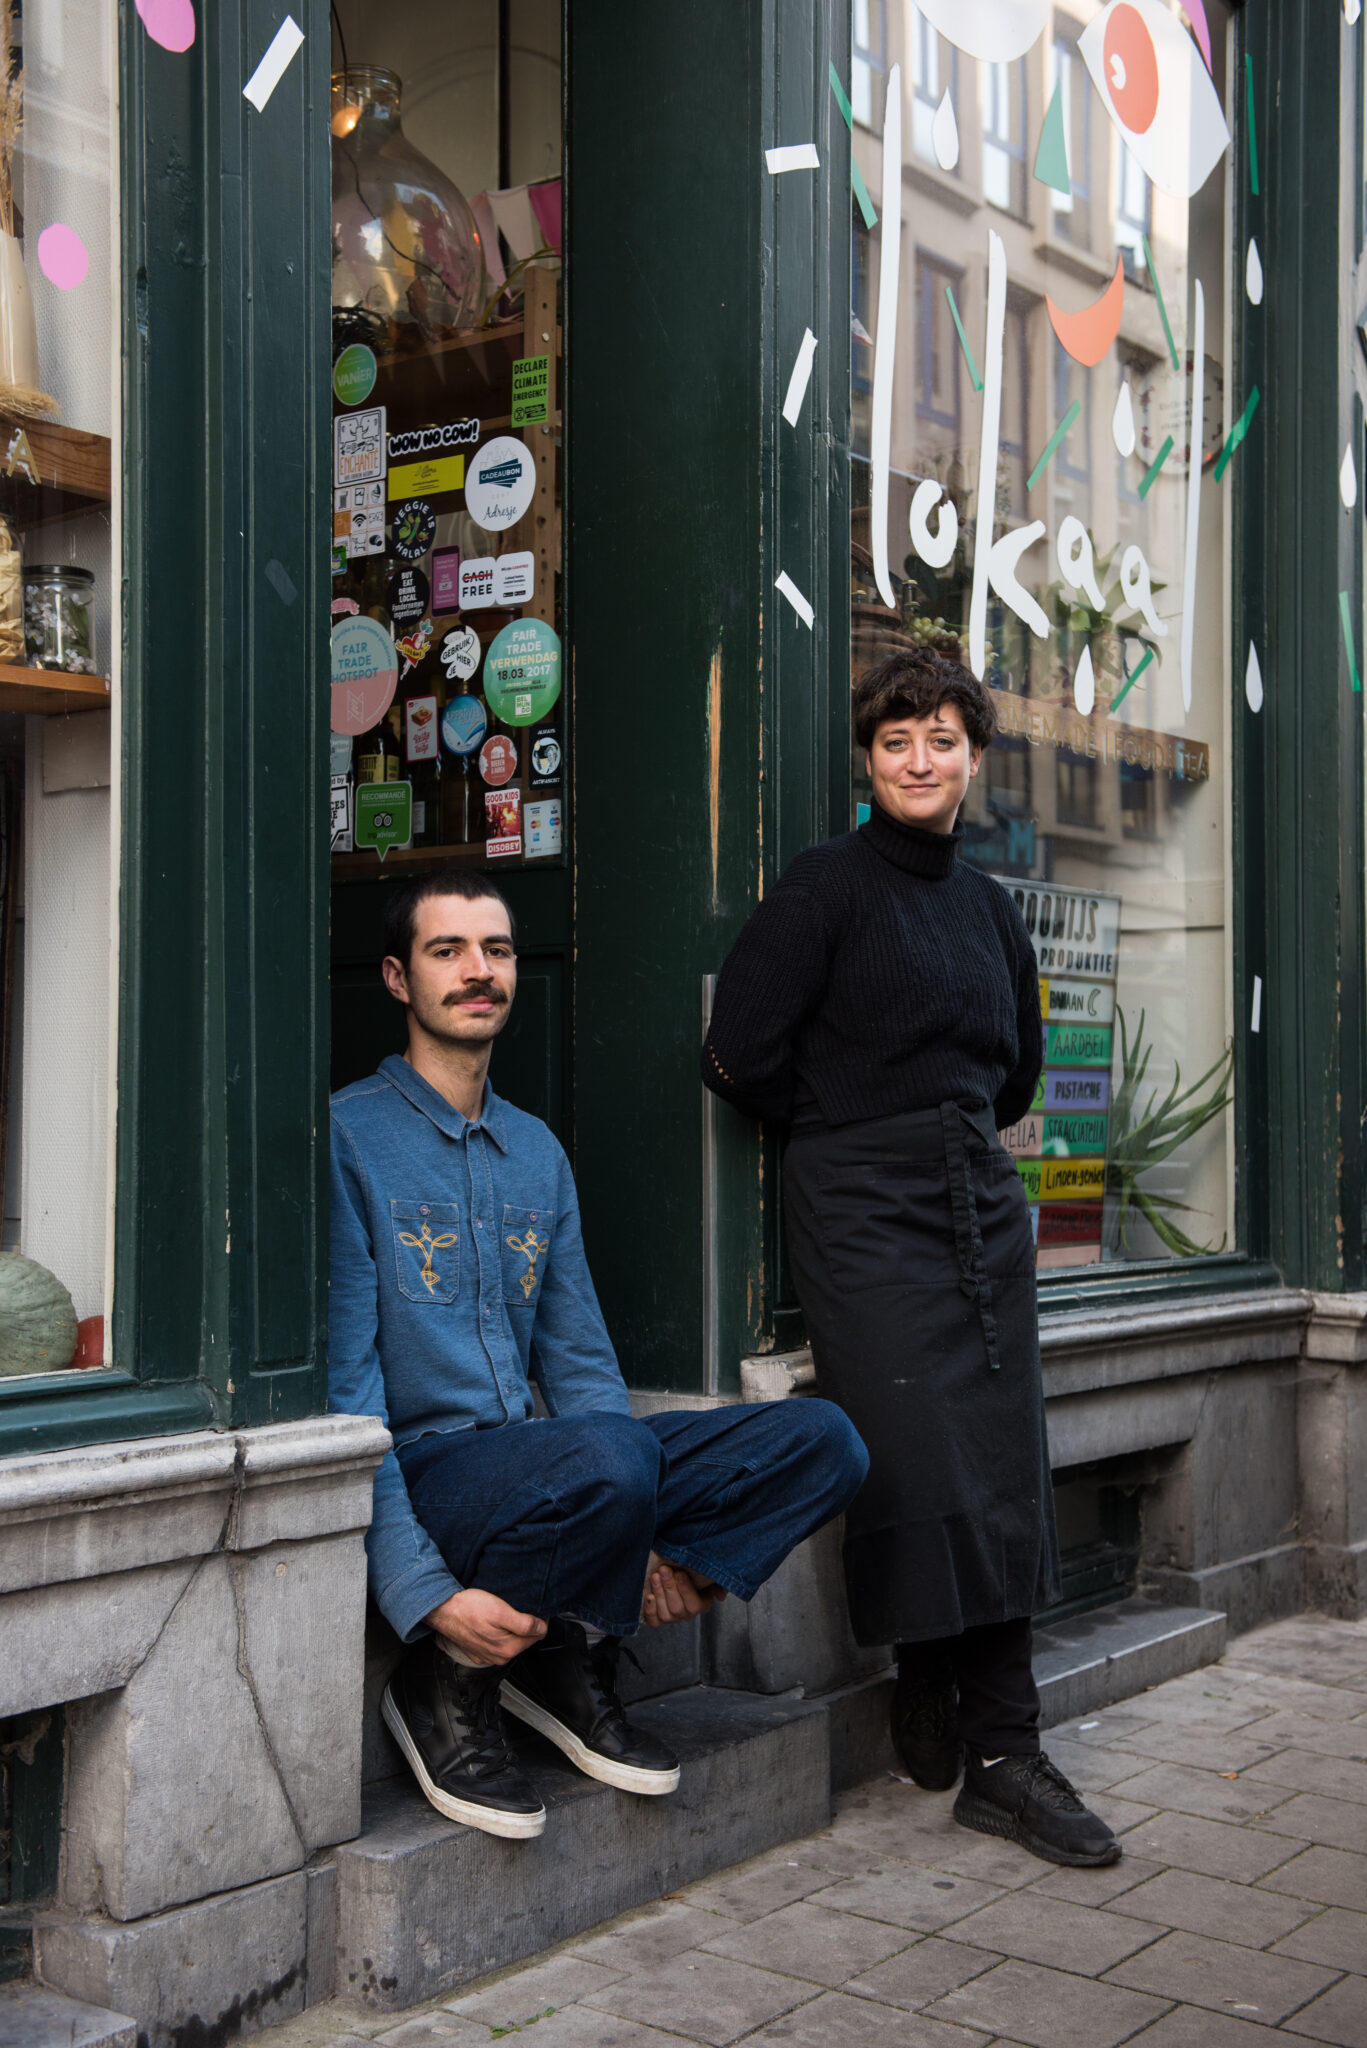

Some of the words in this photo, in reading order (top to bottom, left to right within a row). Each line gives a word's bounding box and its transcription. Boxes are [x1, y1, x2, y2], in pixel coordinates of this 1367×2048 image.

[514, 358, 548, 374] DECLARE
[514, 374, 547, 389] CLIMATE
[872, 62, 1204, 713] lokaal
[513, 388, 546, 401] EMERGENCY
[389, 433, 421, 454] WOW
[422, 431, 441, 448] NO
[442, 421, 478, 443] COW!
[480, 467, 521, 481] CADEAUBON
[393, 500, 430, 525] VEGGIE
[427, 515, 435, 529] IS
[483, 504, 517, 520] Adresje
[396, 541, 427, 559] HALAL
[401, 570, 413, 580] BUY
[462, 569, 493, 583] CASH
[398, 586, 416, 595] DRINK
[402, 579, 414, 587] EAT
[462, 583, 493, 598] FREE
[399, 594, 417, 603] LOCAL
[512, 629, 537, 642] FAIR
[342, 642, 368, 655] FAIR
[442, 637, 471, 660] GEBRUIK
[506, 640, 542, 655] TRADE
[338, 655, 372, 670] TRADE
[456, 653, 471, 666] HIER
[489, 651, 559, 670] VERWENDAG
[331, 667, 379, 684] HOTSPOT
[448, 665, 456, 676] JE
[496, 663, 551, 681] 18.03.2017
[997, 704, 1098, 758] OMEMADE
[361, 791, 406, 801] RECOMMANDÉ
[485, 793, 503, 804] GOOD
[504, 791, 519, 801] KIDS
[488, 841, 519, 853] DISOBEY
[1040, 947, 1113, 973] PRODUKTIE
[1054, 1032, 1104, 1058] AARDBEI
[1055, 1080, 1102, 1101] PISTACHE
